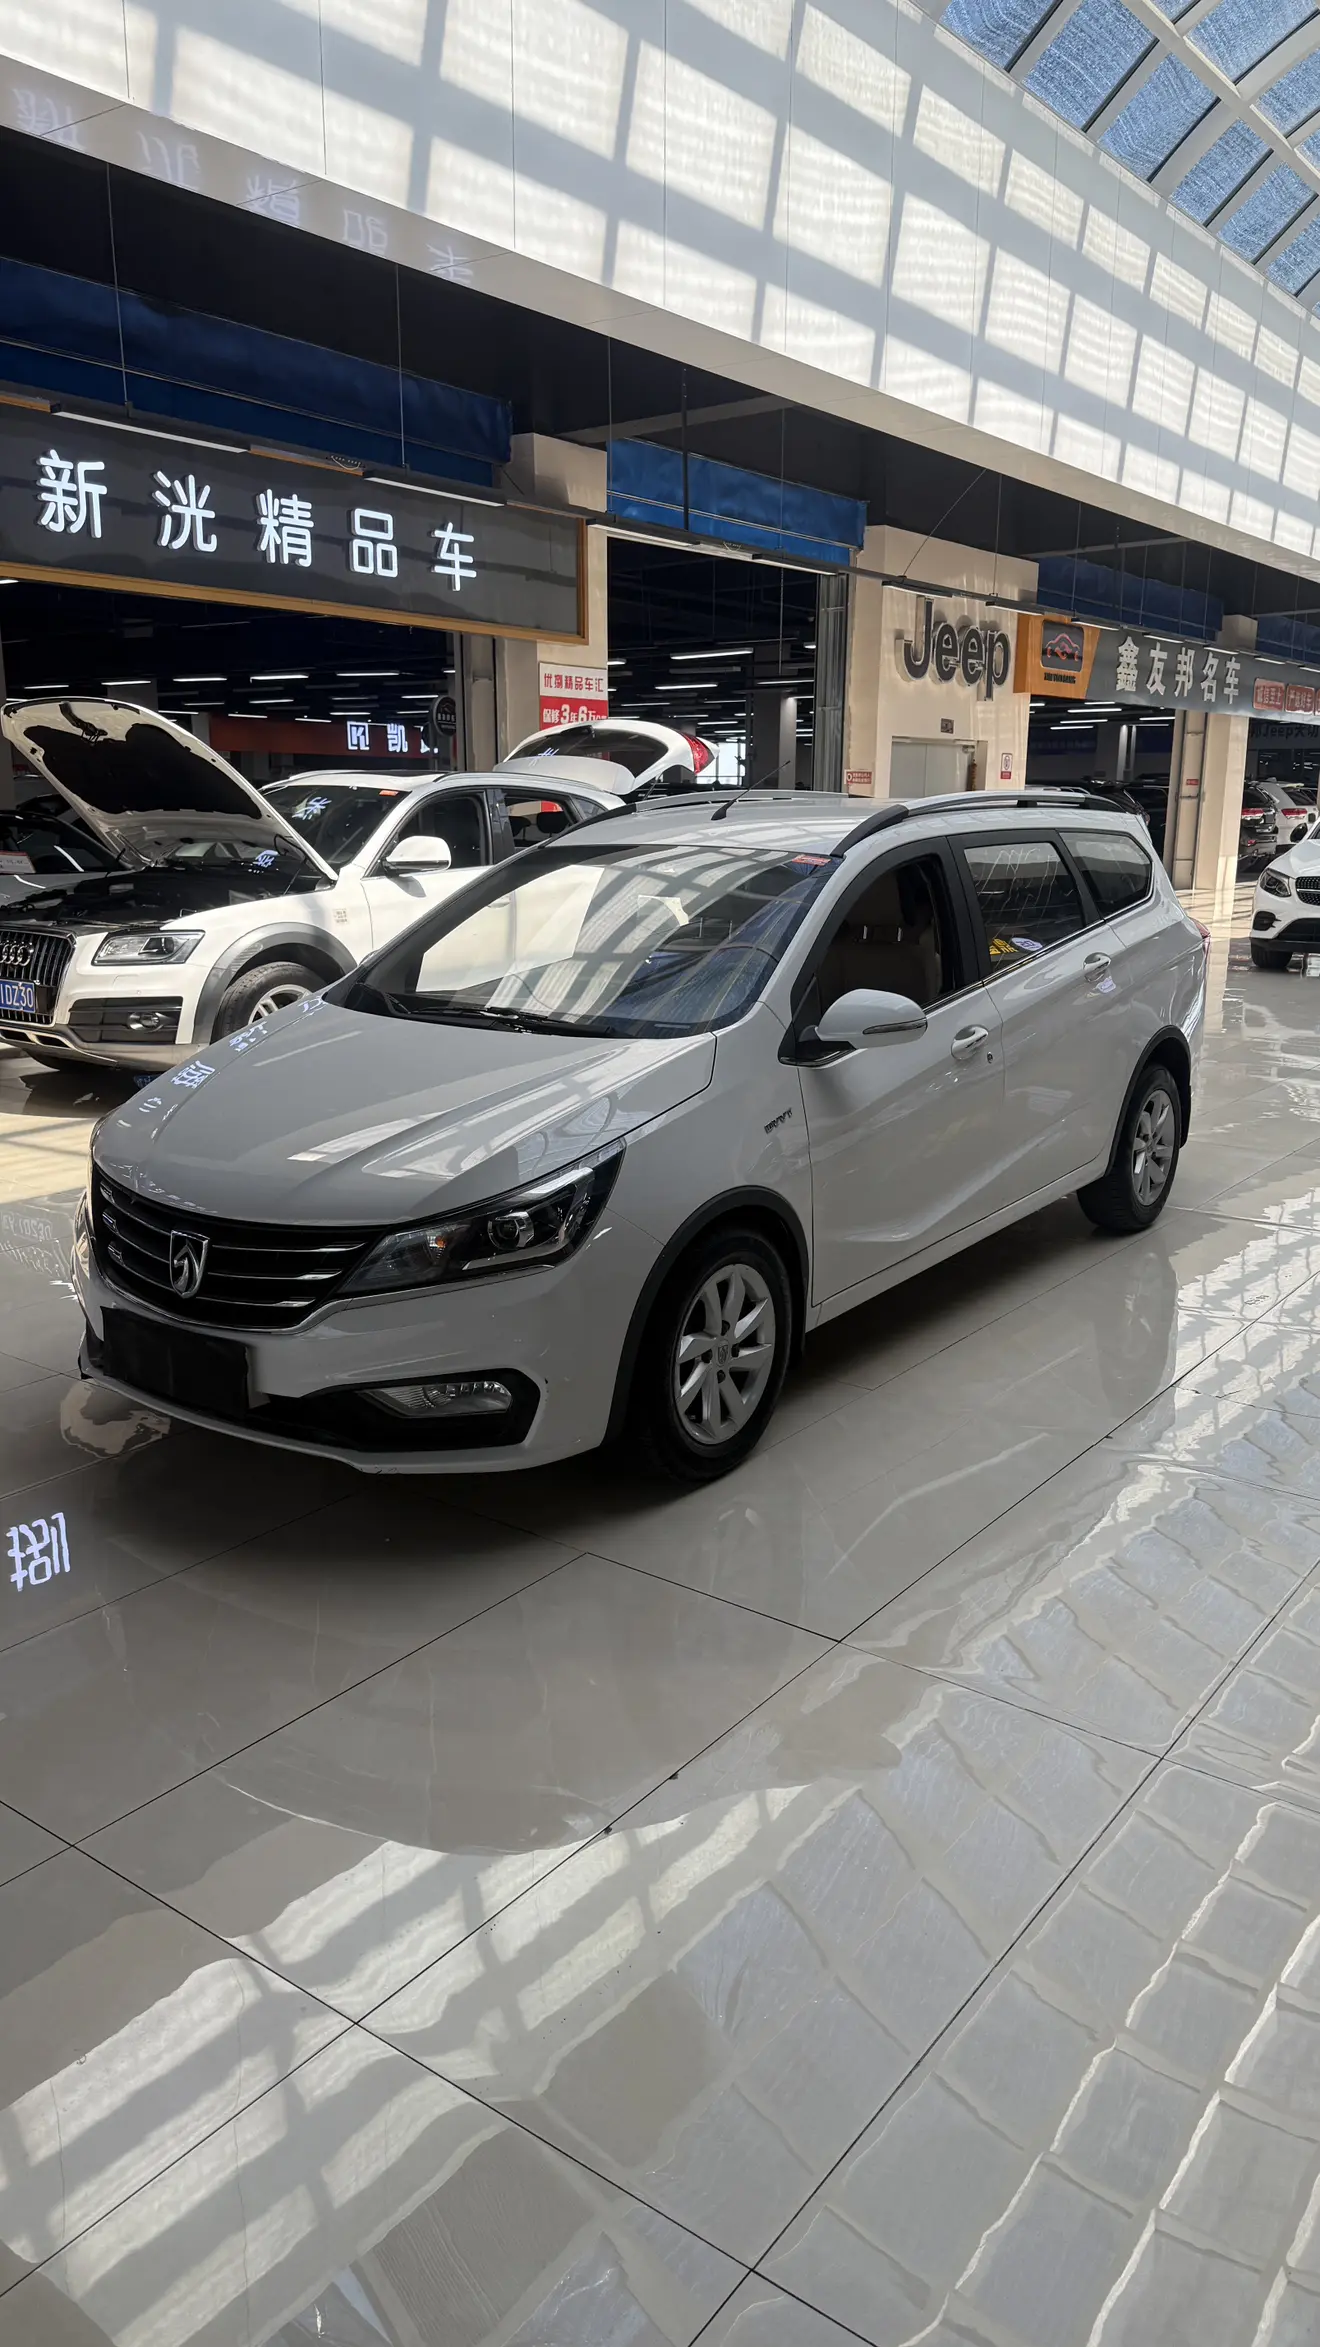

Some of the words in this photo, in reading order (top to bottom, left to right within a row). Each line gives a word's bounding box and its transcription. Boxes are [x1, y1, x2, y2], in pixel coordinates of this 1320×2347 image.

[37, 449, 477, 591] 新洸精品车
[897, 597, 1010, 701] Jeep
[1115, 636, 1241, 704] 鑫友邦名车
